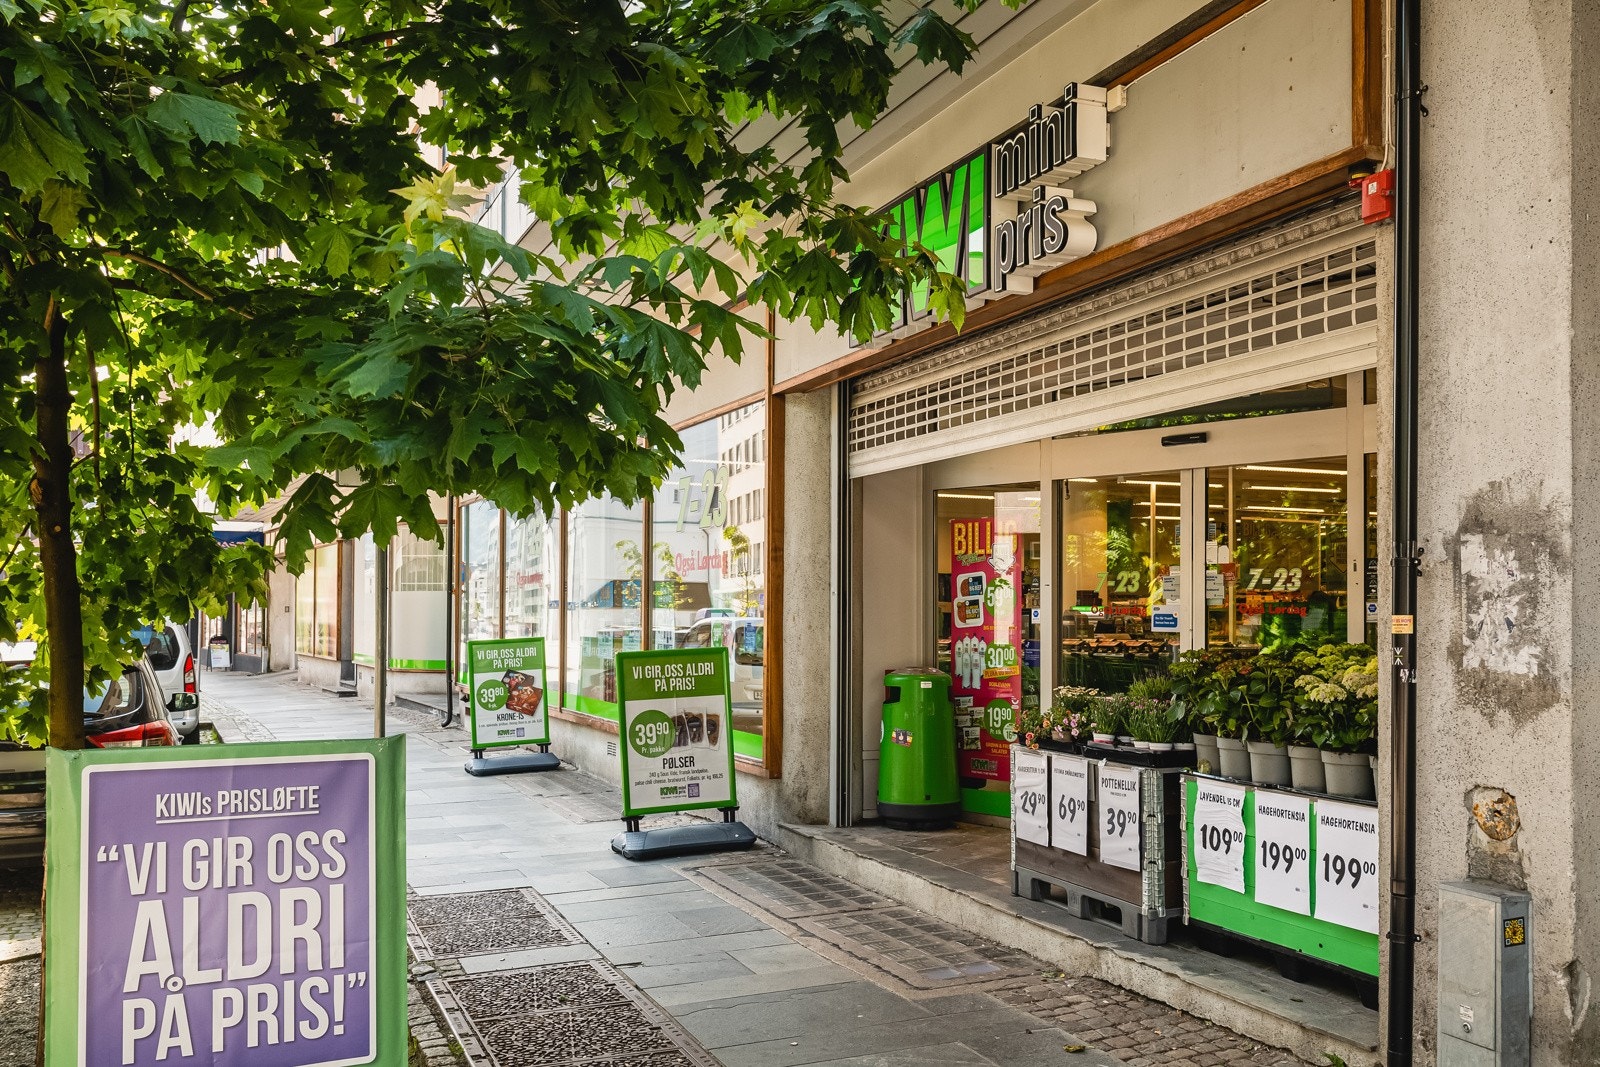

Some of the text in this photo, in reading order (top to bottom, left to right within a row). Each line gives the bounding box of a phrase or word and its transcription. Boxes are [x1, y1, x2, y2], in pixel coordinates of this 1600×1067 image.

[995, 82, 1078, 198] mini
[993, 184, 1069, 292] pris
[676, 465, 729, 533] 7-23
[954, 521, 1018, 555] BILL
[675, 550, 694, 577] Også
[1094, 570, 1141, 593] 7-23
[1246, 567, 1303, 591] 7-23
[477, 646, 537, 660] VI GIR OSS ALDRI
[504, 658, 523, 668] PRIS!
[632, 662, 714, 680] VI GIR OSS ALDRI
[654, 675, 695, 692] PÅ PRIS!
[496, 712, 524, 722] KRONE-IS
[987, 707, 1012, 728] 1990
[636, 721, 670, 746] 3990
[662, 756, 695, 770] PØLSER
[1101, 777, 1136, 792] POTTENELLIK
[217, 784, 320, 815] PRISLØFTE
[1020, 790, 1046, 816] 2990
[1058, 794, 1086, 824] 6990
[1199, 791, 1226, 805] LAVENDEL
[1232, 798, 1241, 809] CM
[1106, 807, 1137, 838] 3990
[1258, 804, 1306, 823] HAGEHORTENSIA
[1320, 814, 1376, 835] HAGEHORTENSIA
[1200, 823, 1244, 855] 10900
[181, 836, 254, 892] GIR
[266, 828, 347, 885] OSS
[1260, 840, 1307, 874] 19900
[1322, 852, 1376, 889] 19900
[122, 883, 345, 993] ALDRI
[121, 976, 195, 1065] PÅ
